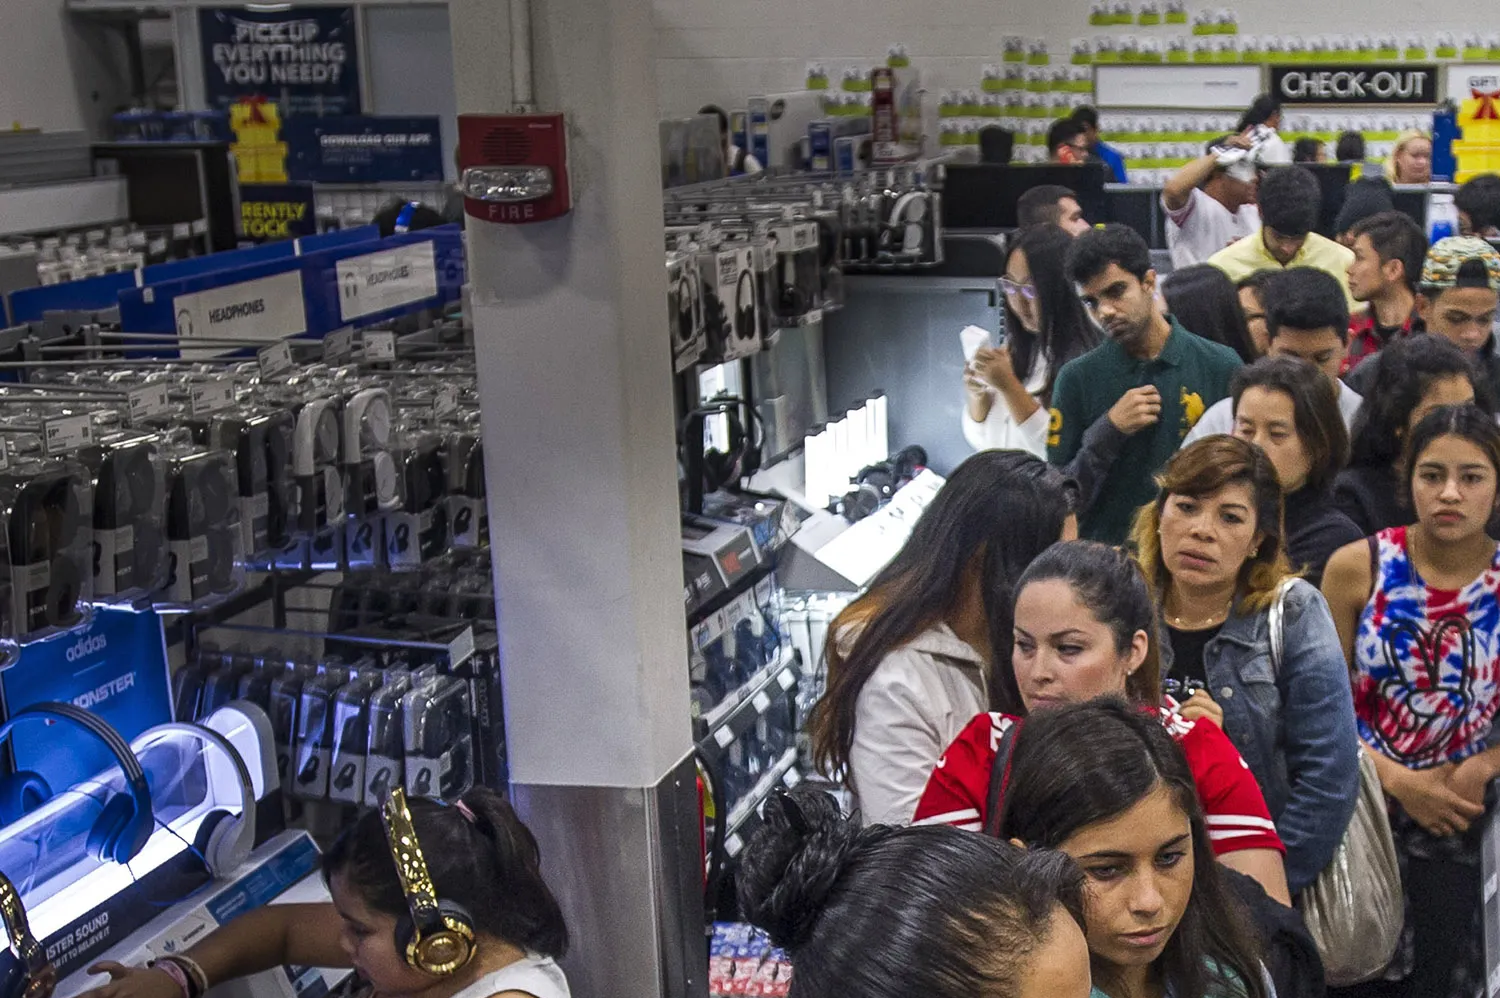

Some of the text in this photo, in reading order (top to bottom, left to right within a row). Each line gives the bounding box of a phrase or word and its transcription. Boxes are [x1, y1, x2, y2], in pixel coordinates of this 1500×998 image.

[235, 21, 320, 42] PICK UP
[212, 42, 347, 63] EVERYTHING
[220, 63, 342, 84] YOU NEED?
[1280, 70, 1428, 98] CHECK-OUT
[1469, 75, 1498, 88] GIFT
[488, 204, 535, 219] FIRE
[365, 264, 410, 288] HEADPHONES
[208, 298, 266, 325] HEADPHONES
[65, 632, 108, 663] adidas
[75, 911, 110, 942] SOUND
